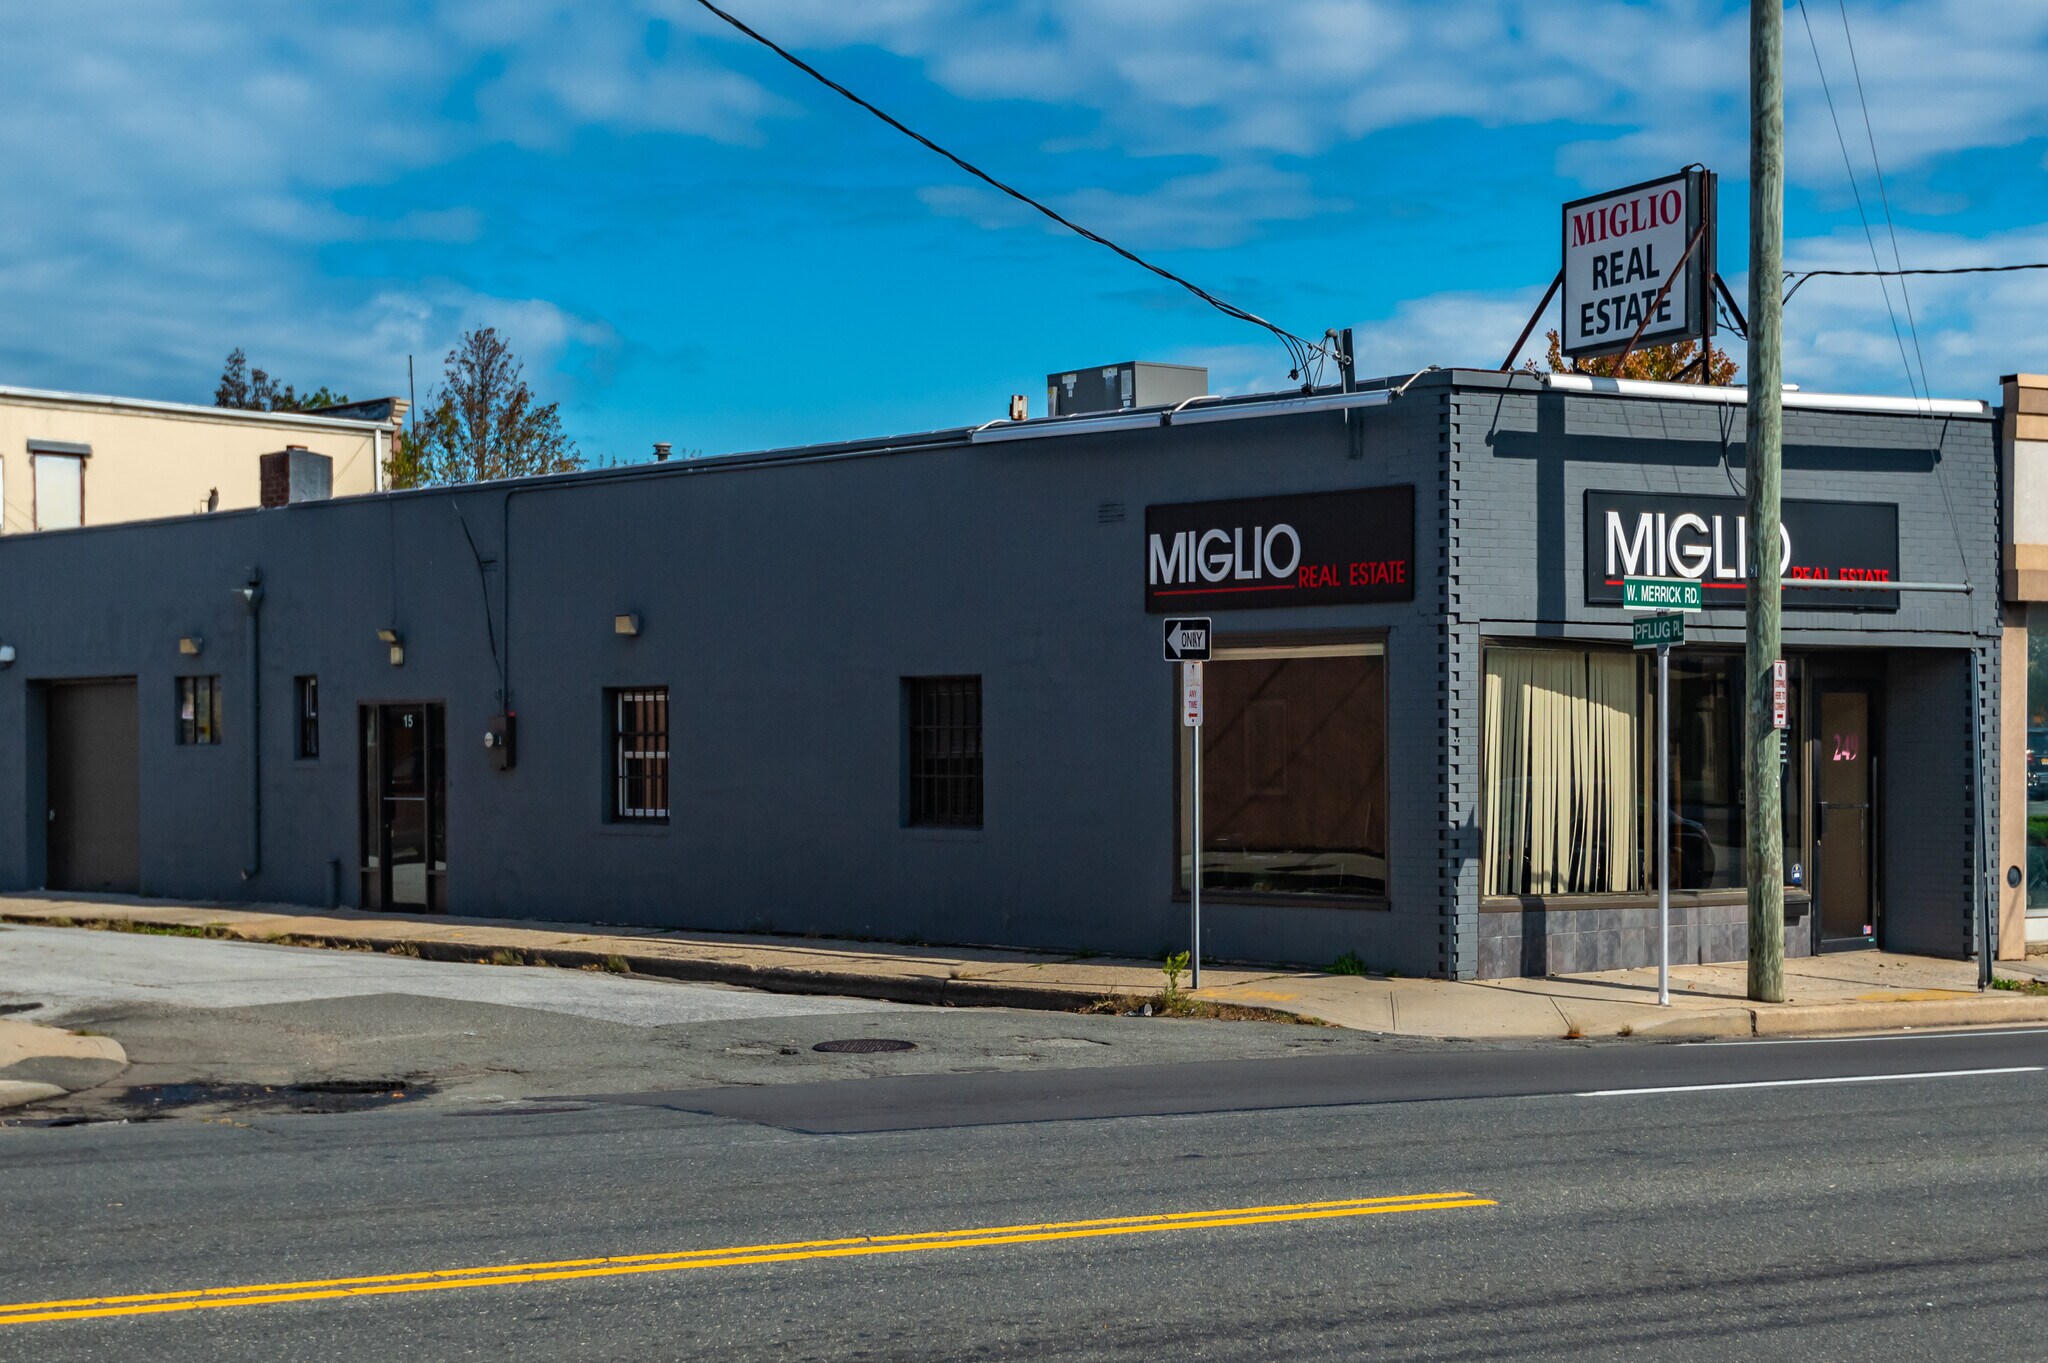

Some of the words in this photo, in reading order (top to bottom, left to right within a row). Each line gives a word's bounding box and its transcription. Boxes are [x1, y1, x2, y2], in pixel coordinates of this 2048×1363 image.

[1572, 189, 1682, 248] MIGLIO
[1592, 244, 1660, 291] REAL
[1581, 287, 1671, 338] ESTATE
[1149, 523, 1301, 585] MIGLIO
[1299, 565, 1341, 588] REAL
[1350, 561, 1406, 586] ESTATE
[1605, 511, 1791, 579] MIGLI
[1626, 584, 1638, 602] W.
[1641, 585, 1682, 604] MERRICK
[1684, 587, 1700, 604] RD.
[1635, 621, 1671, 640] PFLUG
[404, 714, 413, 728] 15
[1833, 735, 1858, 761] 249
